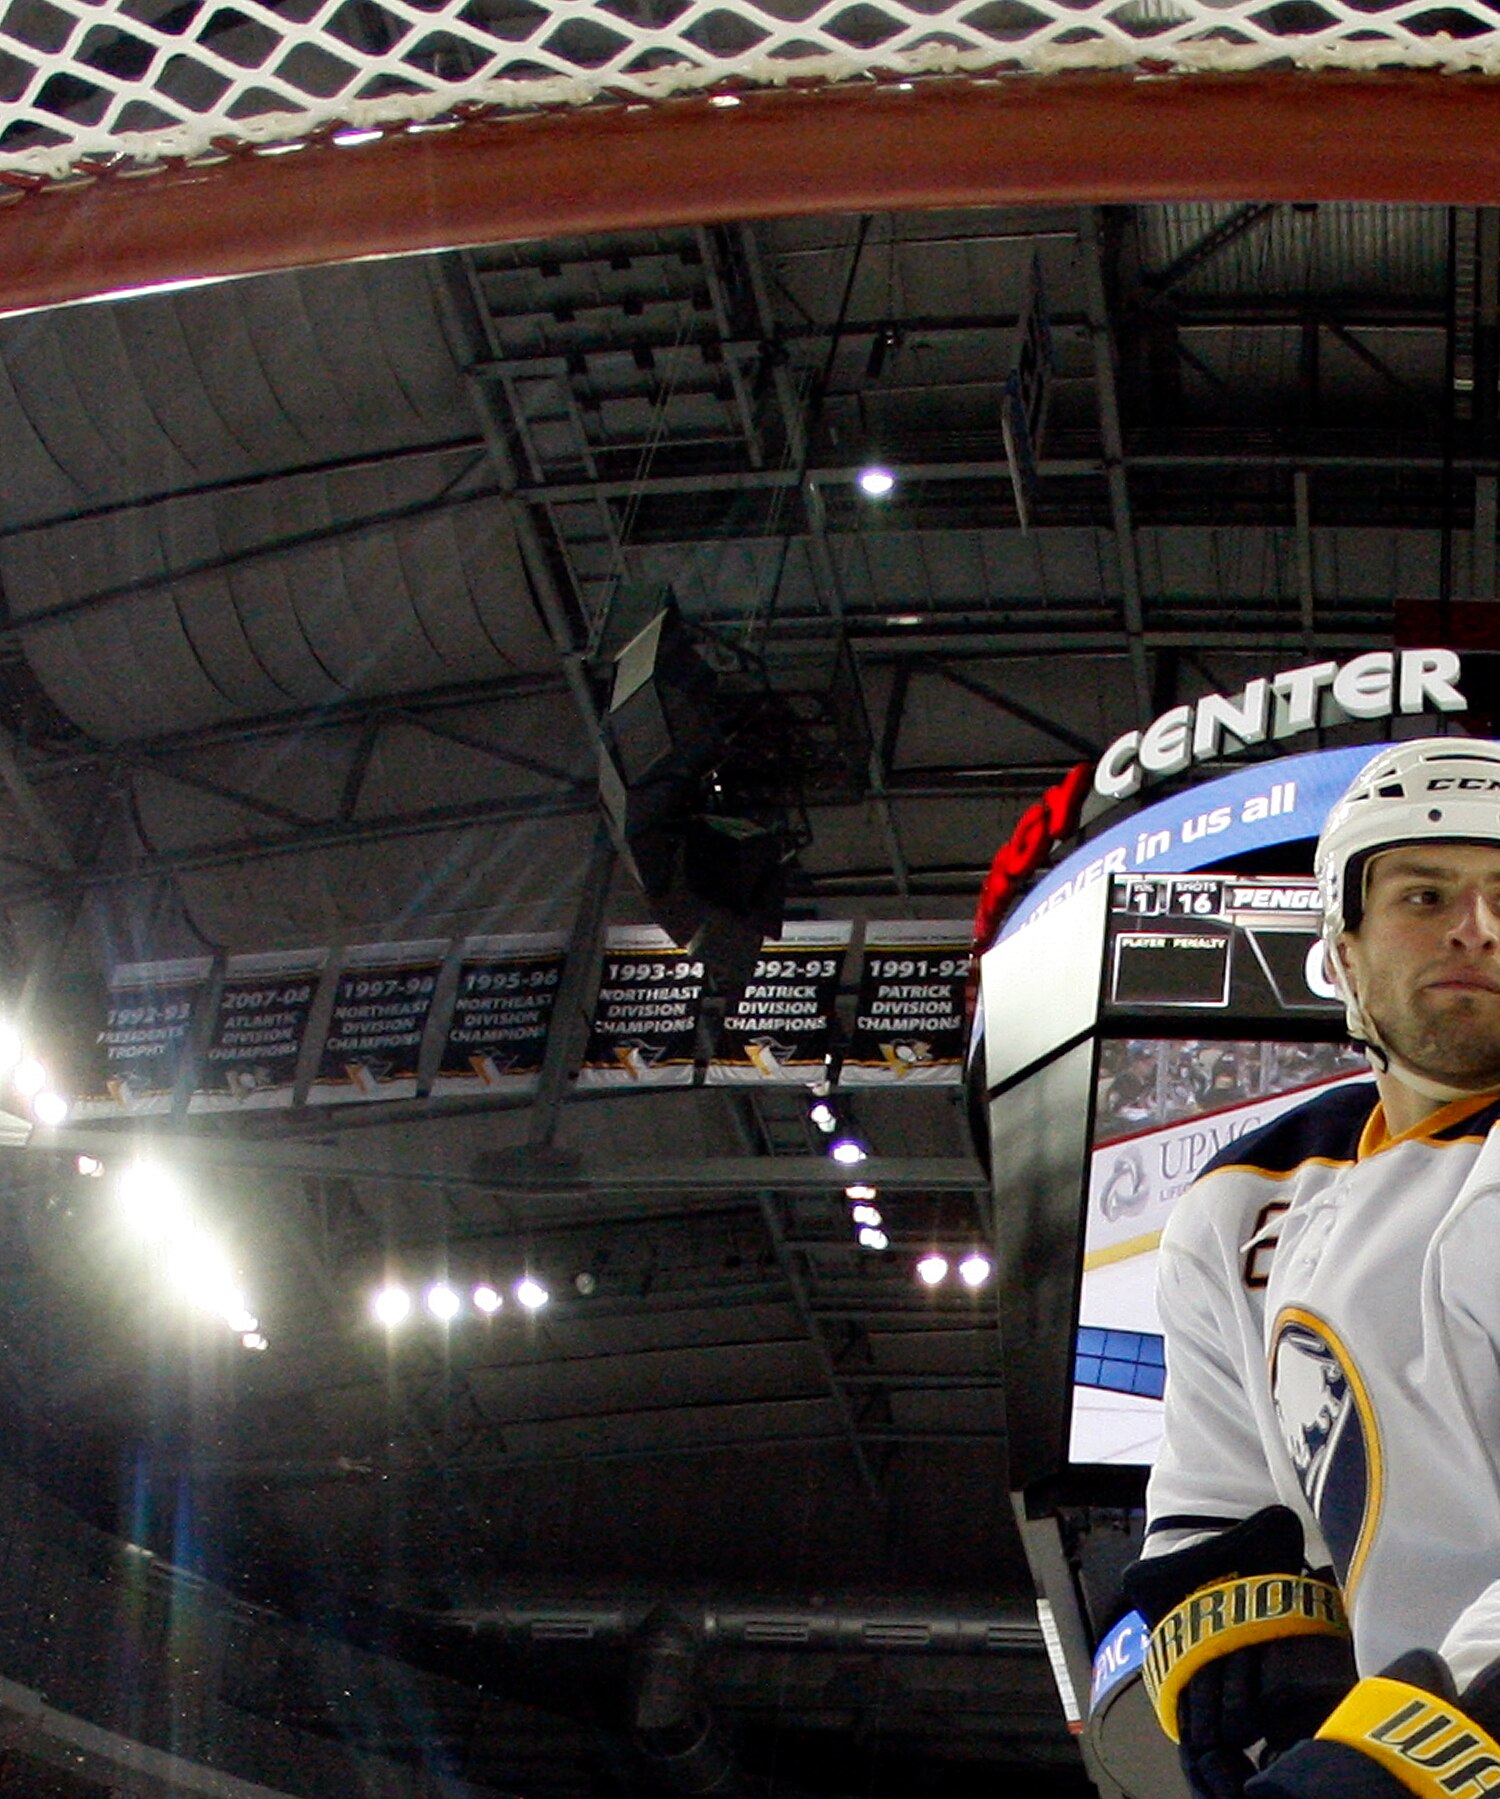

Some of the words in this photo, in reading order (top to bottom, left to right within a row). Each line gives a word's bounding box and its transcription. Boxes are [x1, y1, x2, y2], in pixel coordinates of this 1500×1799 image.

[1093, 649, 1467, 798] CENTER
[1136, 829, 1171, 864] in
[1181, 805, 1232, 843] us
[1241, 781, 1297, 825] all
[1176, 881, 1217, 893] SHOTS
[1134, 893, 1149, 913] 1
[1178, 893, 1213, 914] 16
[1232, 889, 1325, 909] PENGU
[1121, 937, 1166, 949] PLAYER
[1173, 937, 1227, 949] PENALTY
[609, 961, 704, 982] 1993-94
[869, 958, 971, 979] 1991-92
[465, 969, 559, 991] 1995-96
[600, 984, 702, 1001] NORTHEAST
[744, 985, 818, 1000] PATRICK
[877, 985, 952, 1000] PATRICK
[333, 1000, 430, 1021] NORTHEAST
[455, 994, 553, 1011] NORTHEAST
[607, 1002, 686, 1018] DIVISION
[737, 1001, 818, 1016] DIVISION
[871, 1000, 953, 1016] DIVISION
[224, 1012, 297, 1029] ATLANTIC
[341, 1017, 416, 1034] DIVISION
[465, 1009, 539, 1028] DIVISION
[595, 1015, 695, 1034] CHAMPIONS
[724, 1014, 827, 1032] CHAMPIONS
[857, 1014, 962, 1032] CHAMPIONS
[222, 1028, 293, 1045] DIVISION
[326, 1032, 422, 1051] CHAMPIONS
[107, 1043, 166, 1061] TROPHY
[208, 1043, 298, 1061] CHAMPIONS
